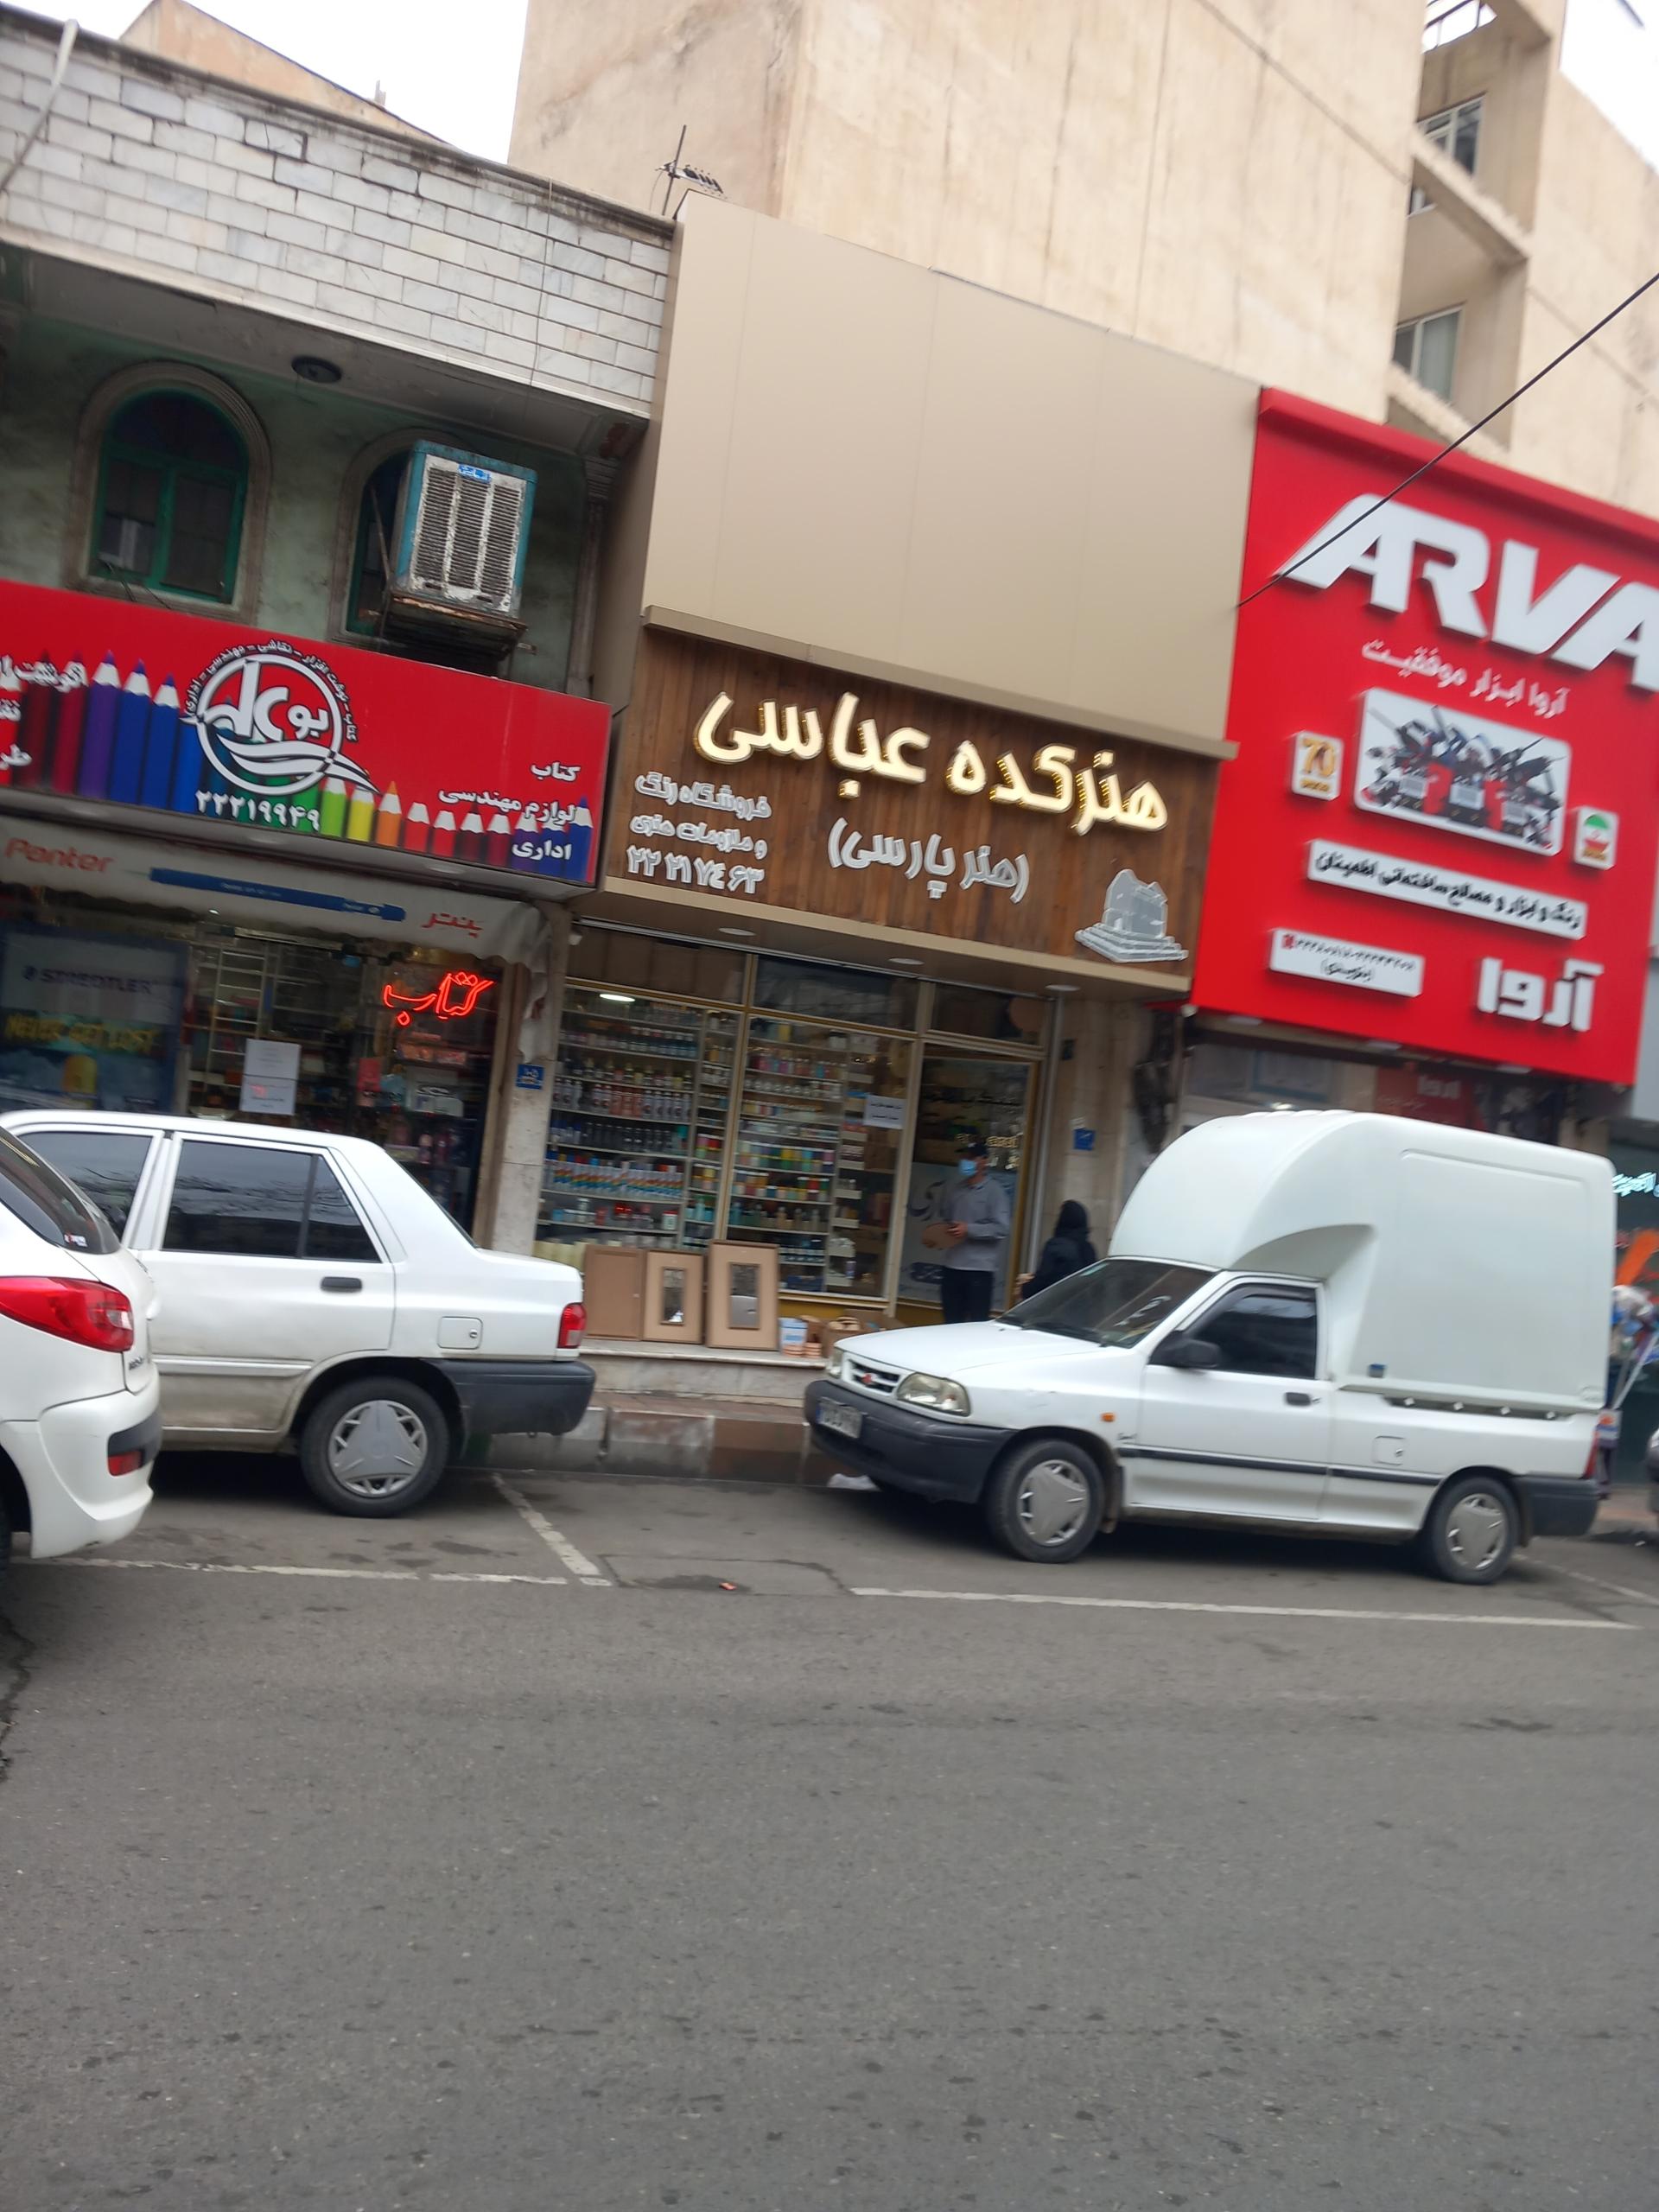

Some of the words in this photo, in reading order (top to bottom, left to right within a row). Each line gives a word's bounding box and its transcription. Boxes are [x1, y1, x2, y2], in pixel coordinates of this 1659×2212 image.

[1273, 493, 1659, 695] ARVA
[1362, 639, 1468, 689] موفقیت
[693, 691, 931, 799] عباسی
[530, 761, 582, 783] کتاب
[634, 771, 678, 805] رنگ
[947, 740, 1168, 836] هنرکده
[195, 789, 321, 831] ۲۲۲۱۹۹۴۹
[437, 788, 523, 813] مهندسی
[524, 800, 578, 826] لوازم
[678, 781, 772, 821] فروشگاه
[4, 837, 115, 872] Panter
[512, 838, 573, 861] اداری
[753, 839, 768, 860] و
[421, 912, 483, 938] پنتر
[383, 971, 494, 1027] کتاب
[1477, 956, 1605, 1033] آروا
